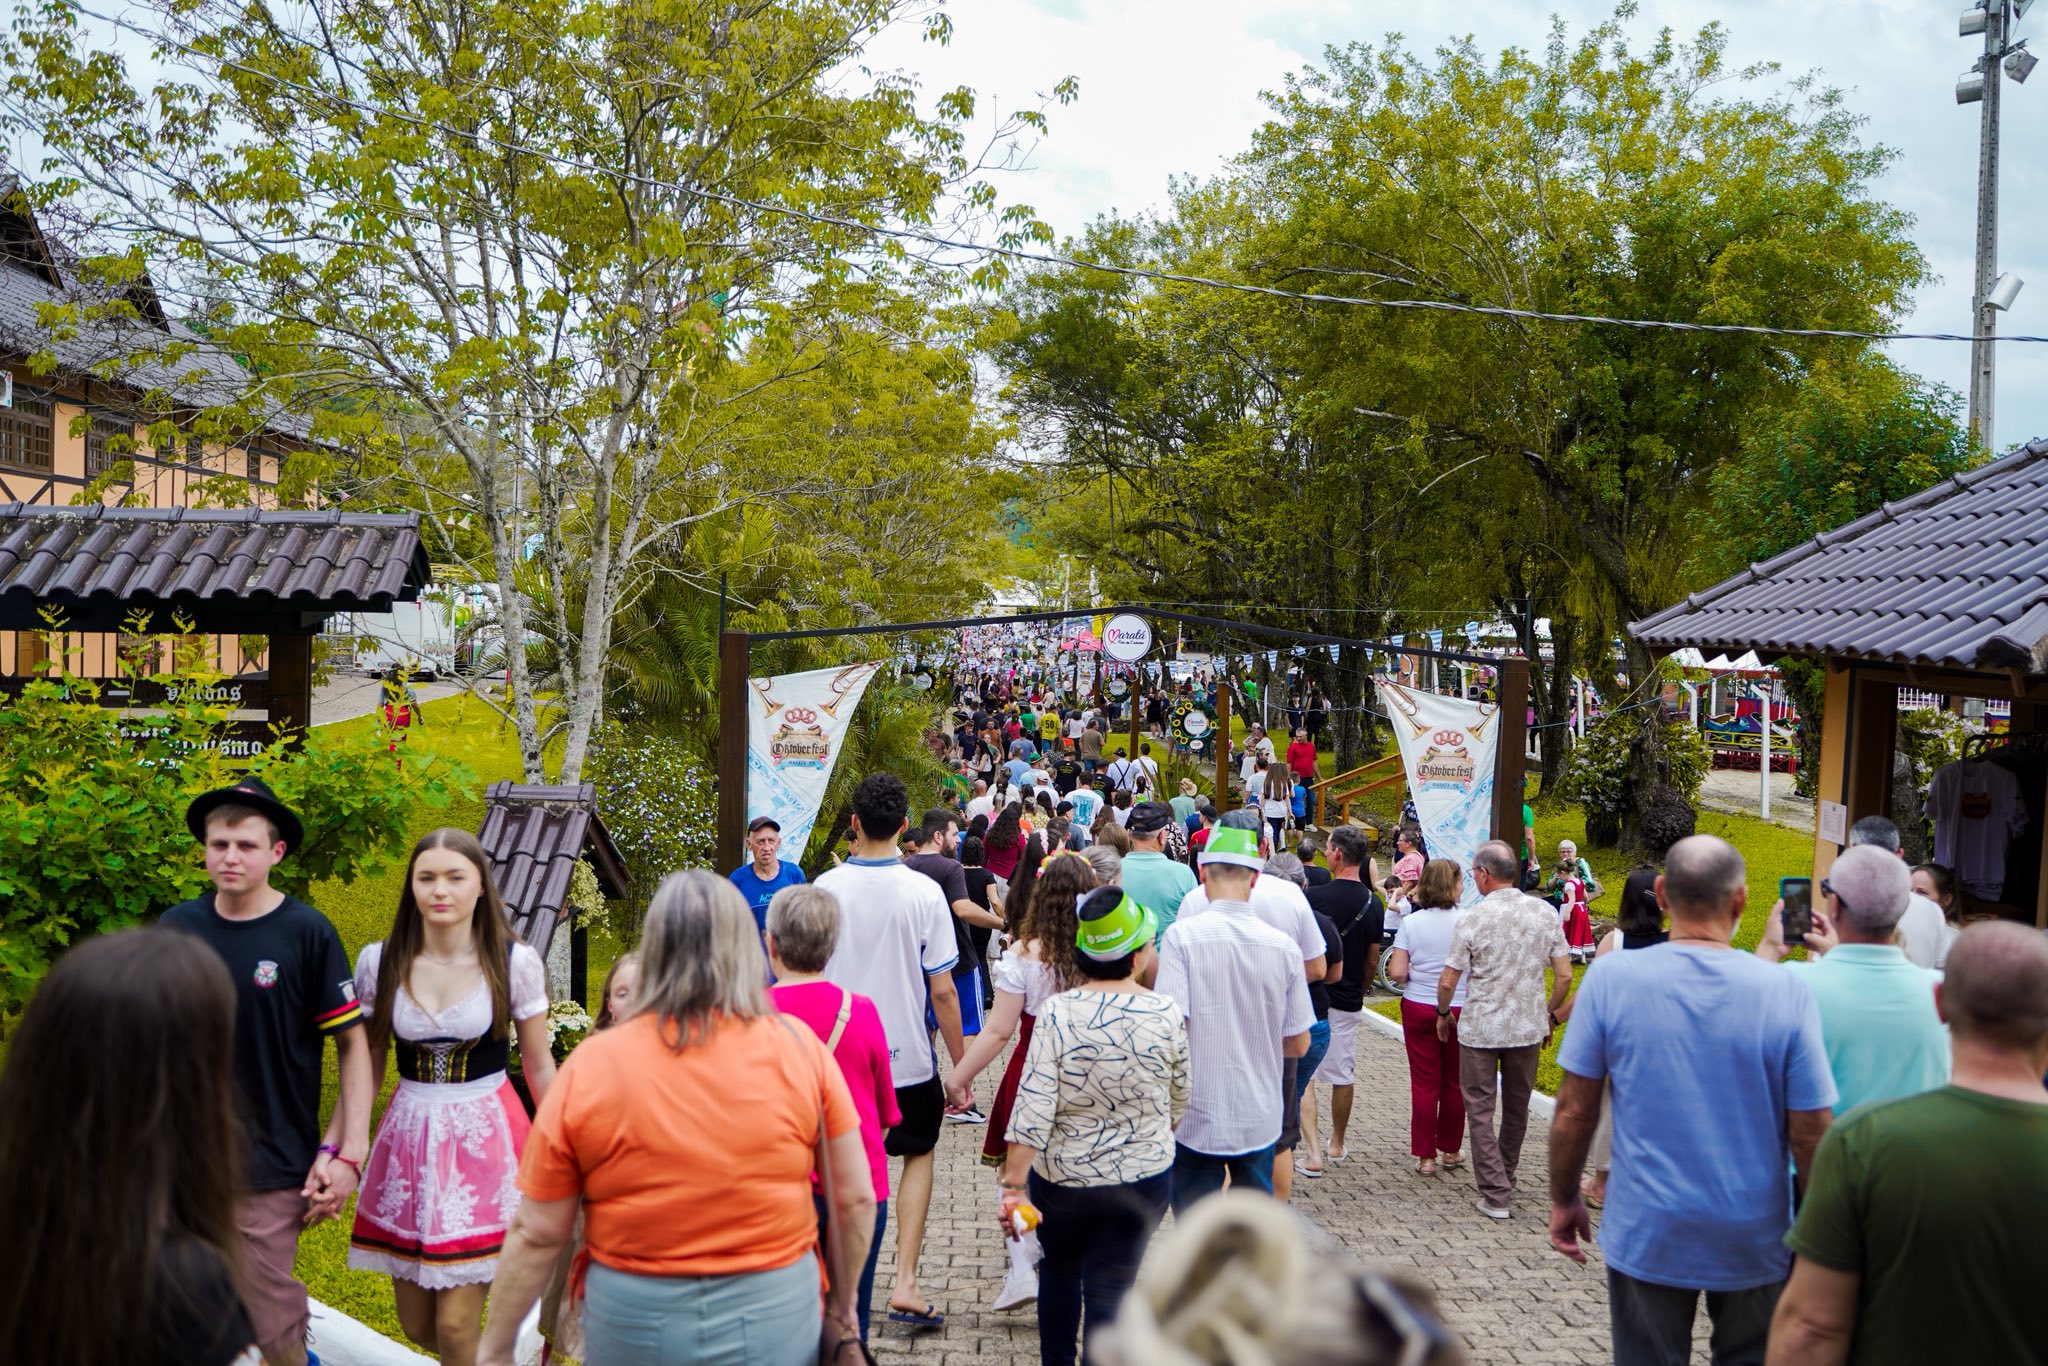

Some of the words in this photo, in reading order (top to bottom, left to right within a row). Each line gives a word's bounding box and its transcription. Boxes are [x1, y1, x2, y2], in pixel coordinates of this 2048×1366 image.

[1045, 720, 1055, 729] 50
[772, 741, 828, 757] Oktoberfest
[1418, 763, 1474, 779] Oktoberfest
[1095, 927, 1124, 943] Sicredi
